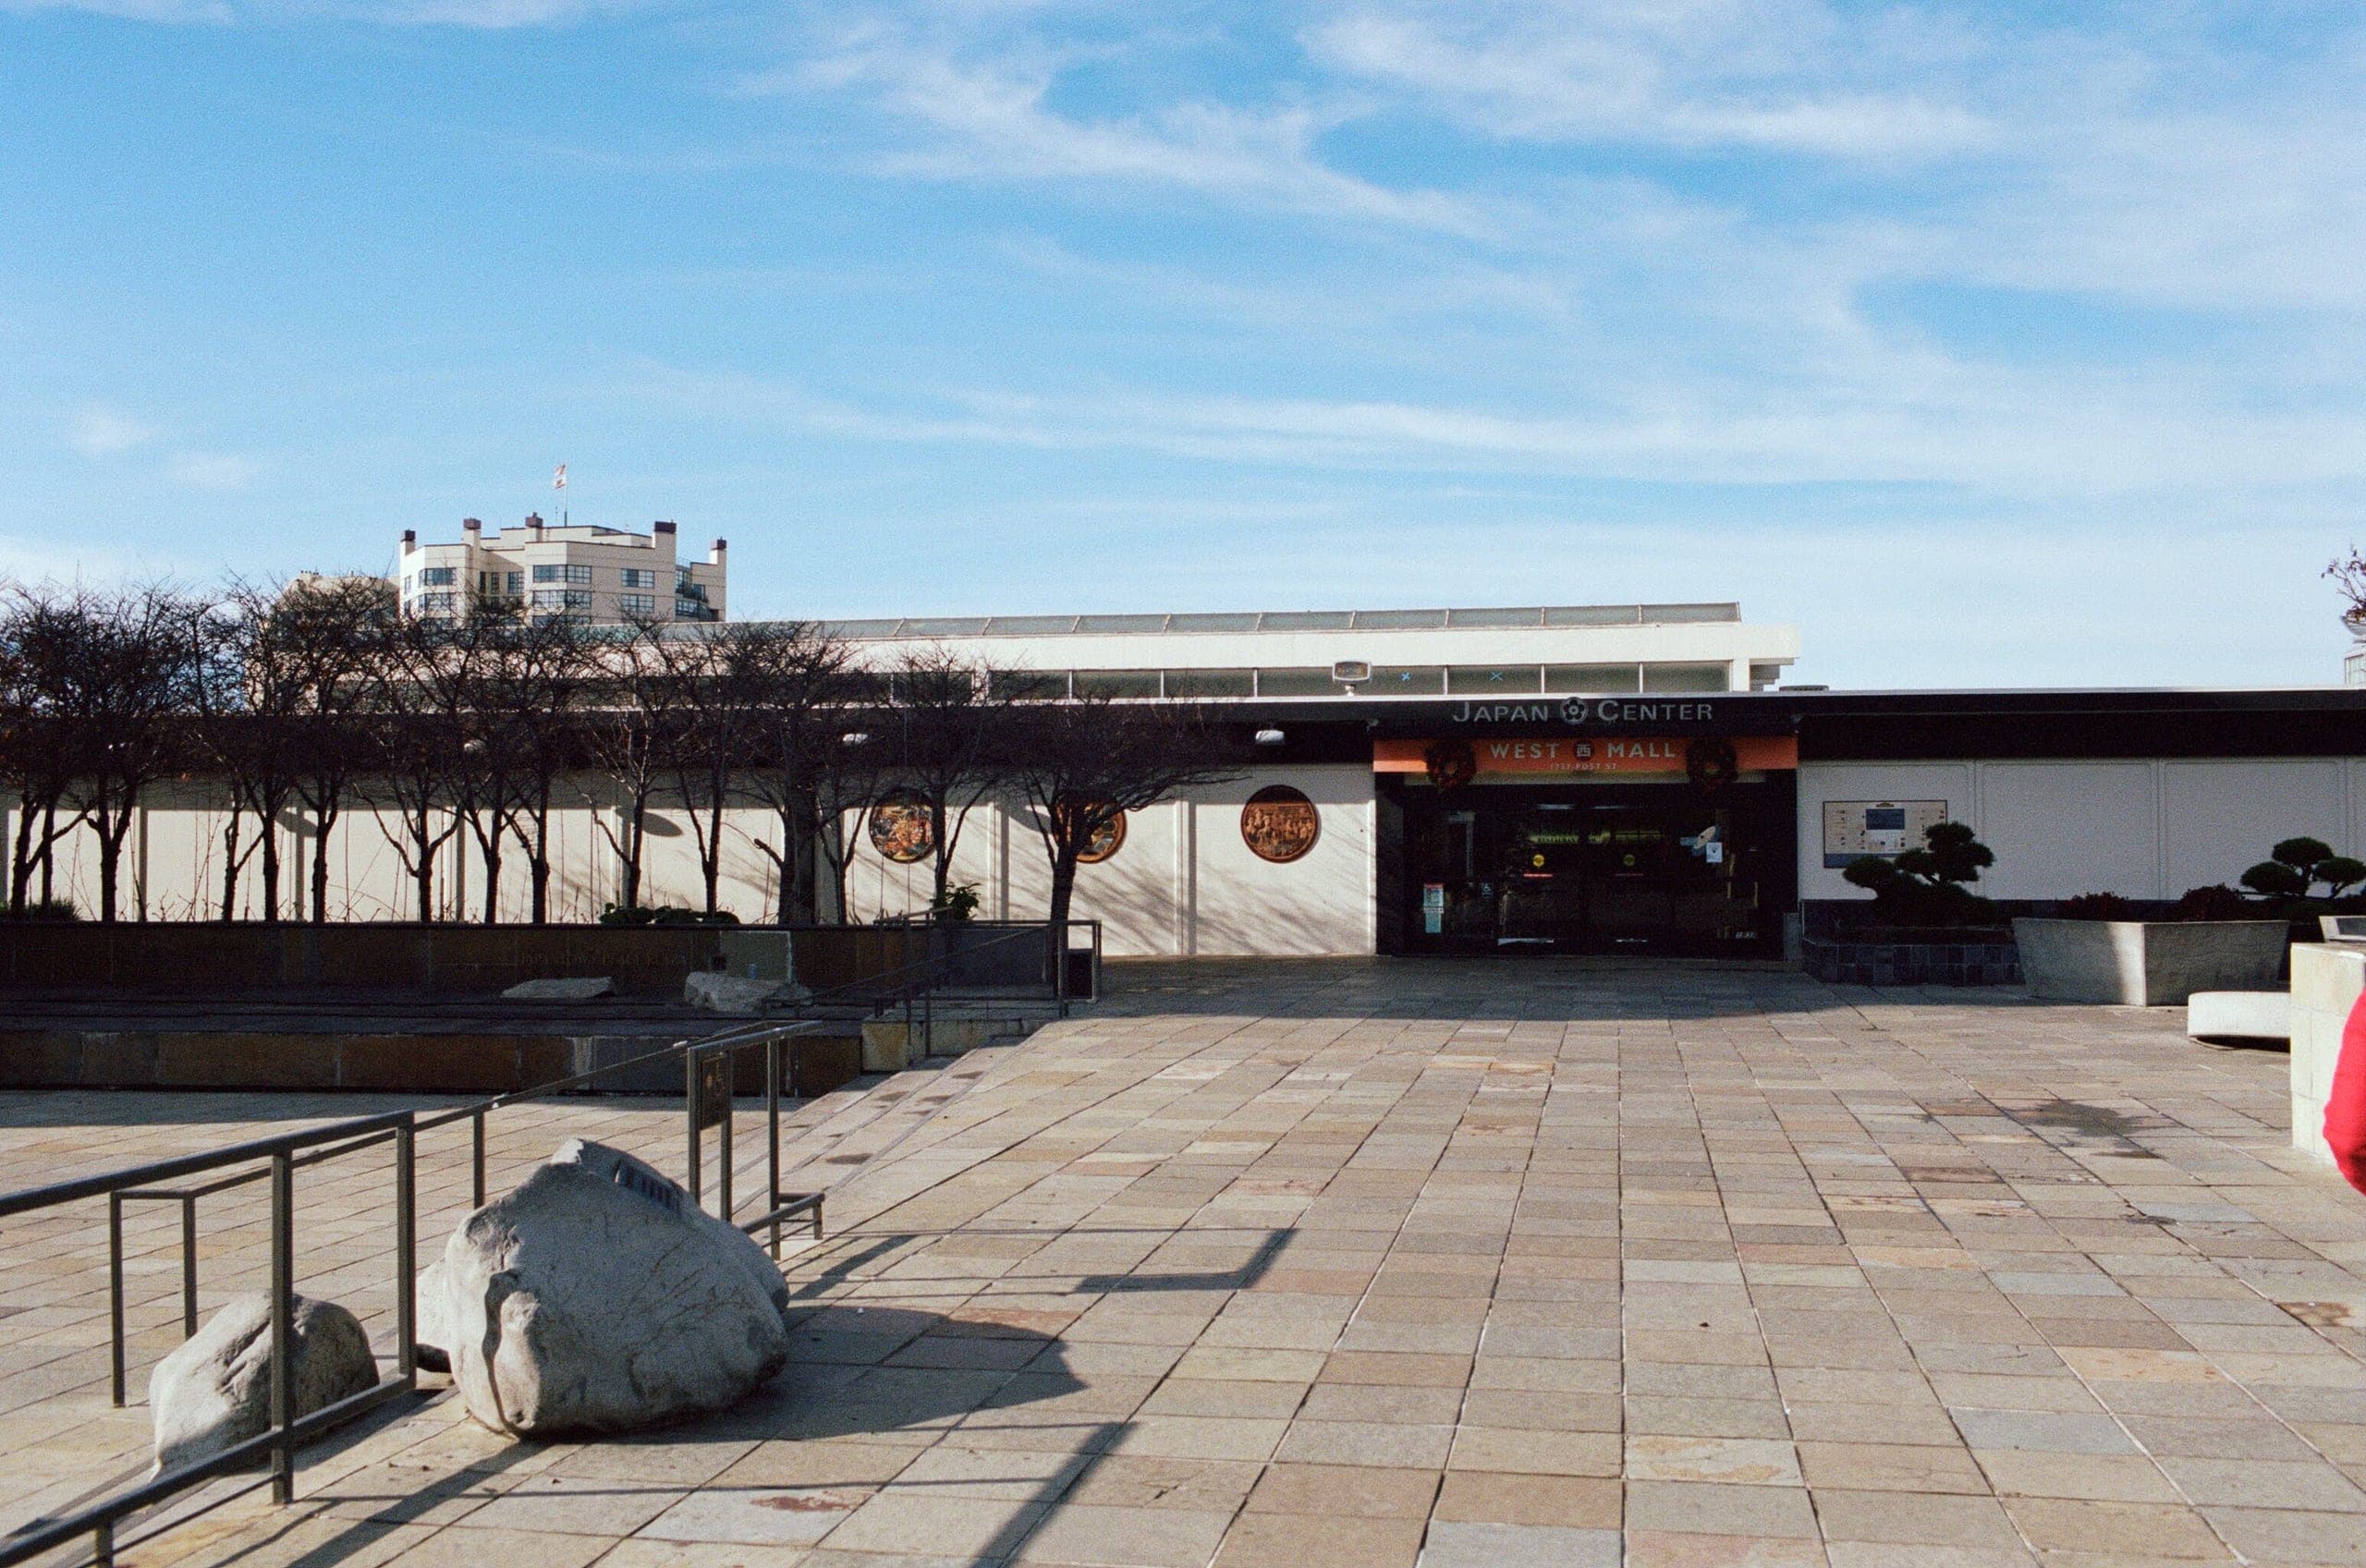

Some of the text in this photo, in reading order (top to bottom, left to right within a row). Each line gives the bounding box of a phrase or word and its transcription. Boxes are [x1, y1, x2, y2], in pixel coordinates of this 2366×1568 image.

[1453, 699, 1714, 722] JAPAN CENTER
[1490, 742, 1676, 759] WEST 西 MALL
[1575, 762, 1601, 771] POST
[1604, 762, 1617, 771] ST
